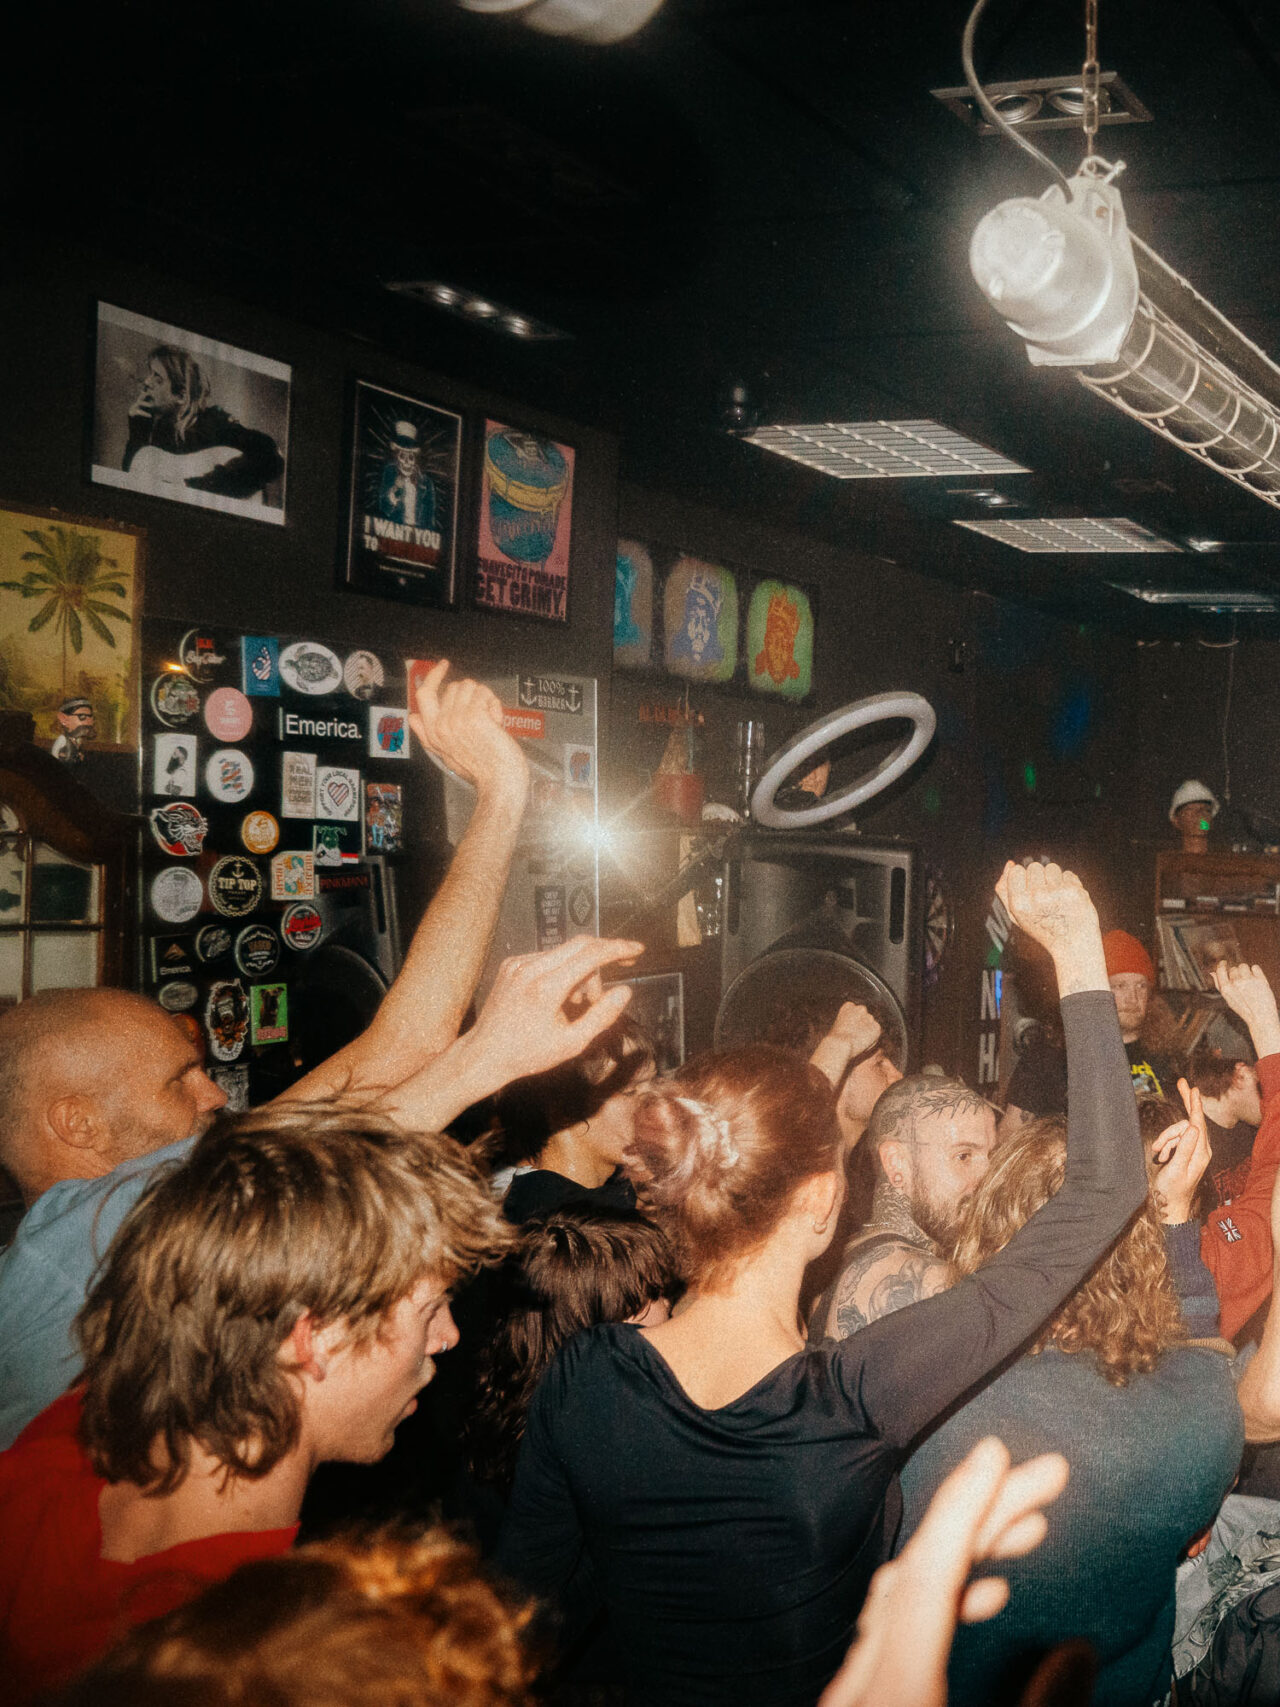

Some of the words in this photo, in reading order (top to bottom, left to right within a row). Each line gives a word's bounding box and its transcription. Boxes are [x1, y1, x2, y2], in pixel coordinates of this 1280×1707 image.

[363, 534, 379, 551] TO
[364, 515, 371, 534] I
[373, 517, 410, 543] WANT
[414, 528, 441, 550] YOU
[477, 573, 508, 604] GET
[285, 713, 362, 739] Emerica.
[218, 877, 236, 889] TIP
[238, 878, 258, 891] TOP
